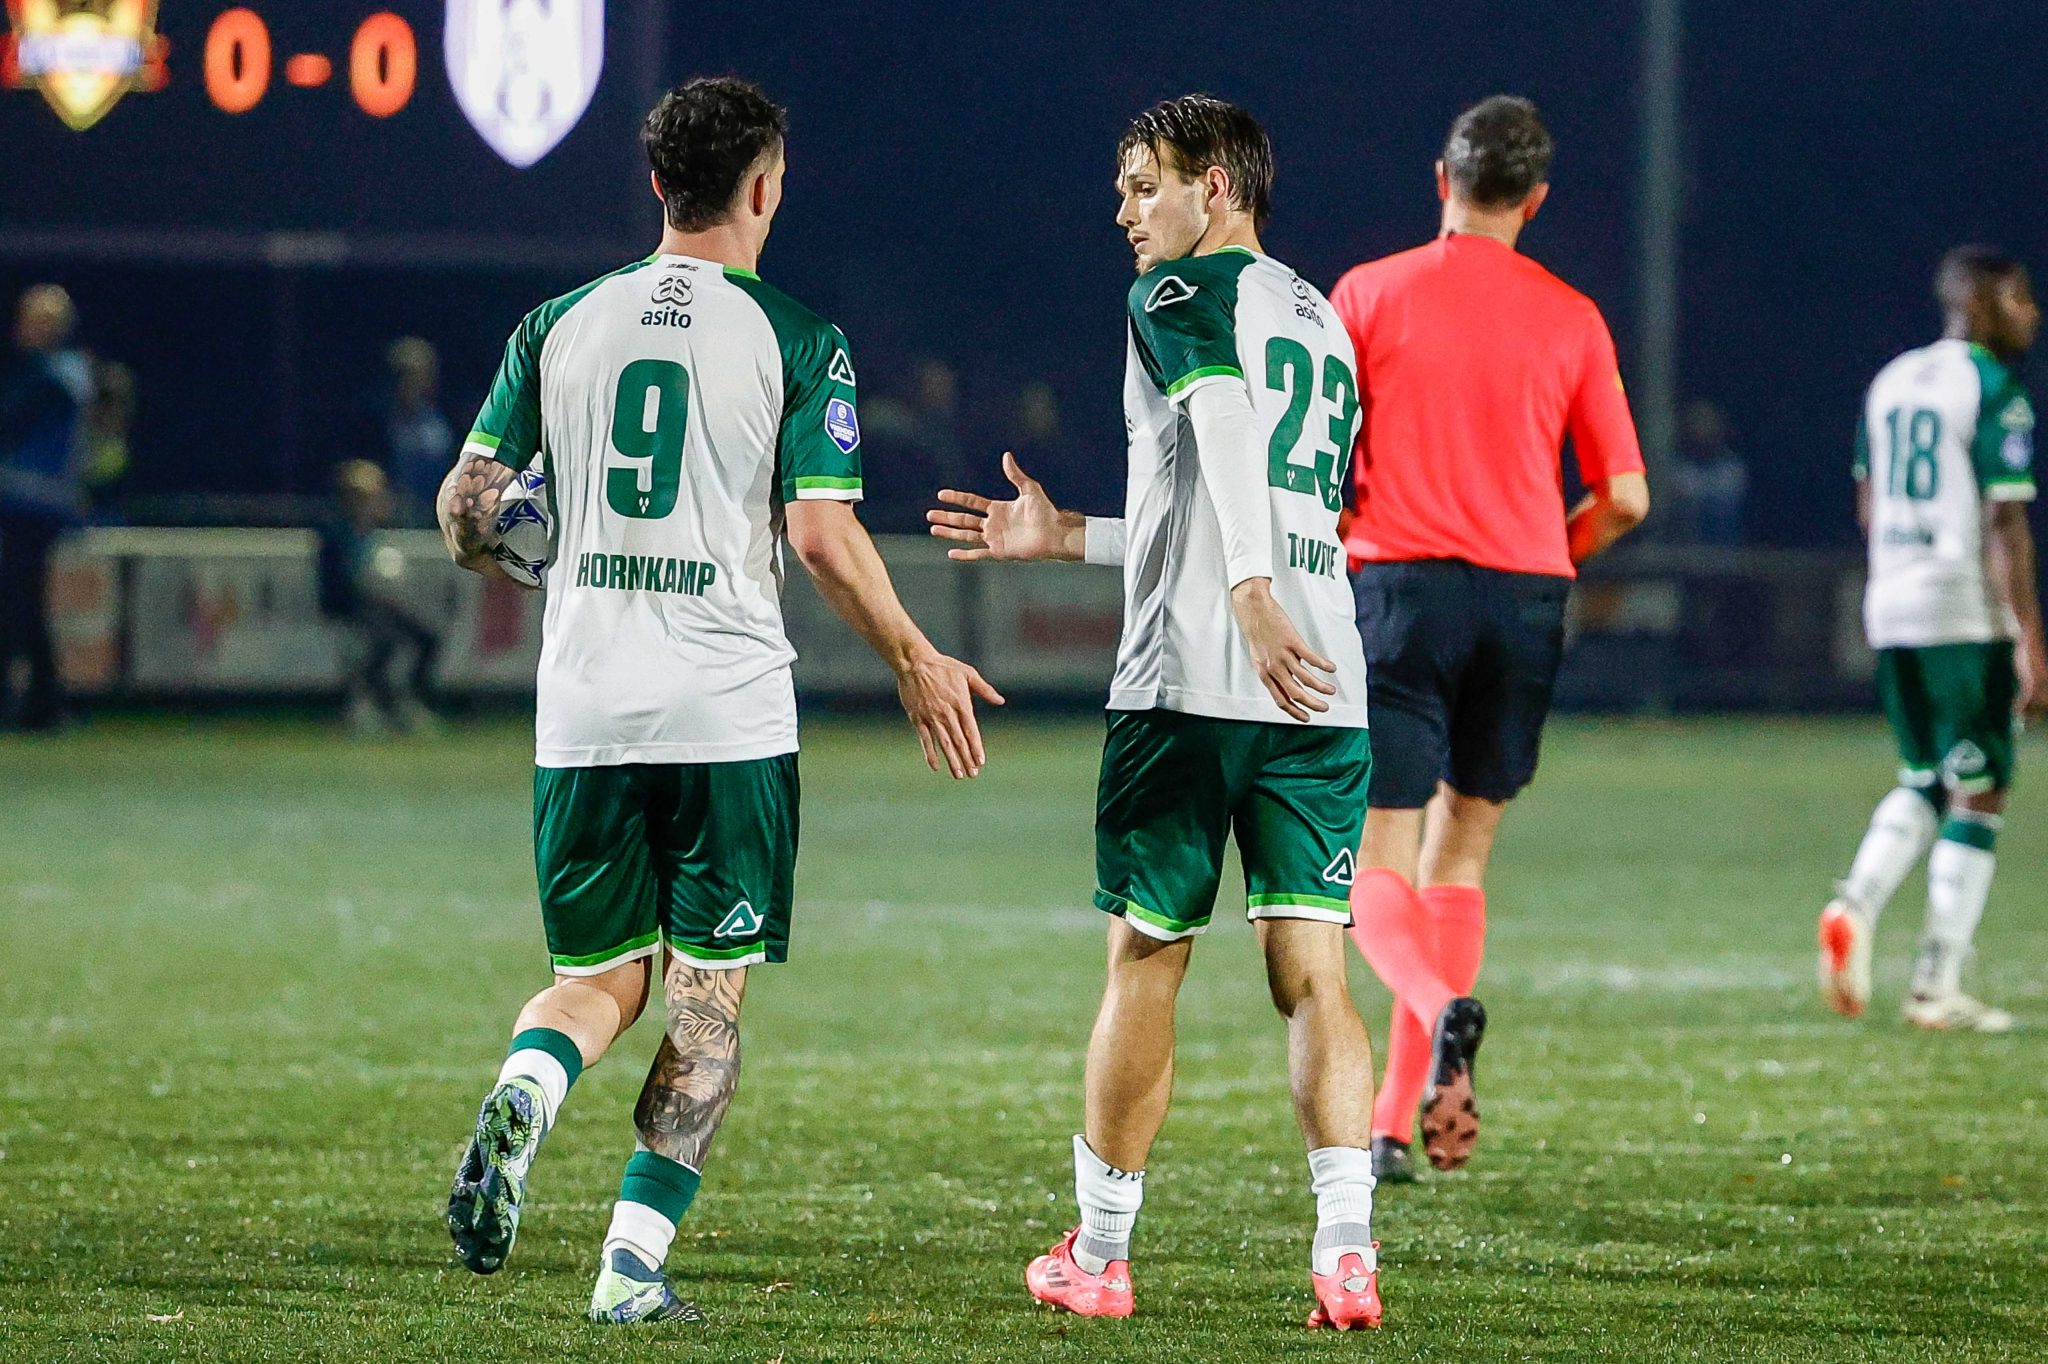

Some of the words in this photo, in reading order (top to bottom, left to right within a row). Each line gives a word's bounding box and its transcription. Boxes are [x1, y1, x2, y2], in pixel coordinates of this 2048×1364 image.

[641, 306, 692, 328] asito
[606, 359, 690, 519] 9
[1265, 336, 1359, 513] 23
[1886, 406, 1941, 501] 18
[576, 552, 716, 597] HORNKAMP
